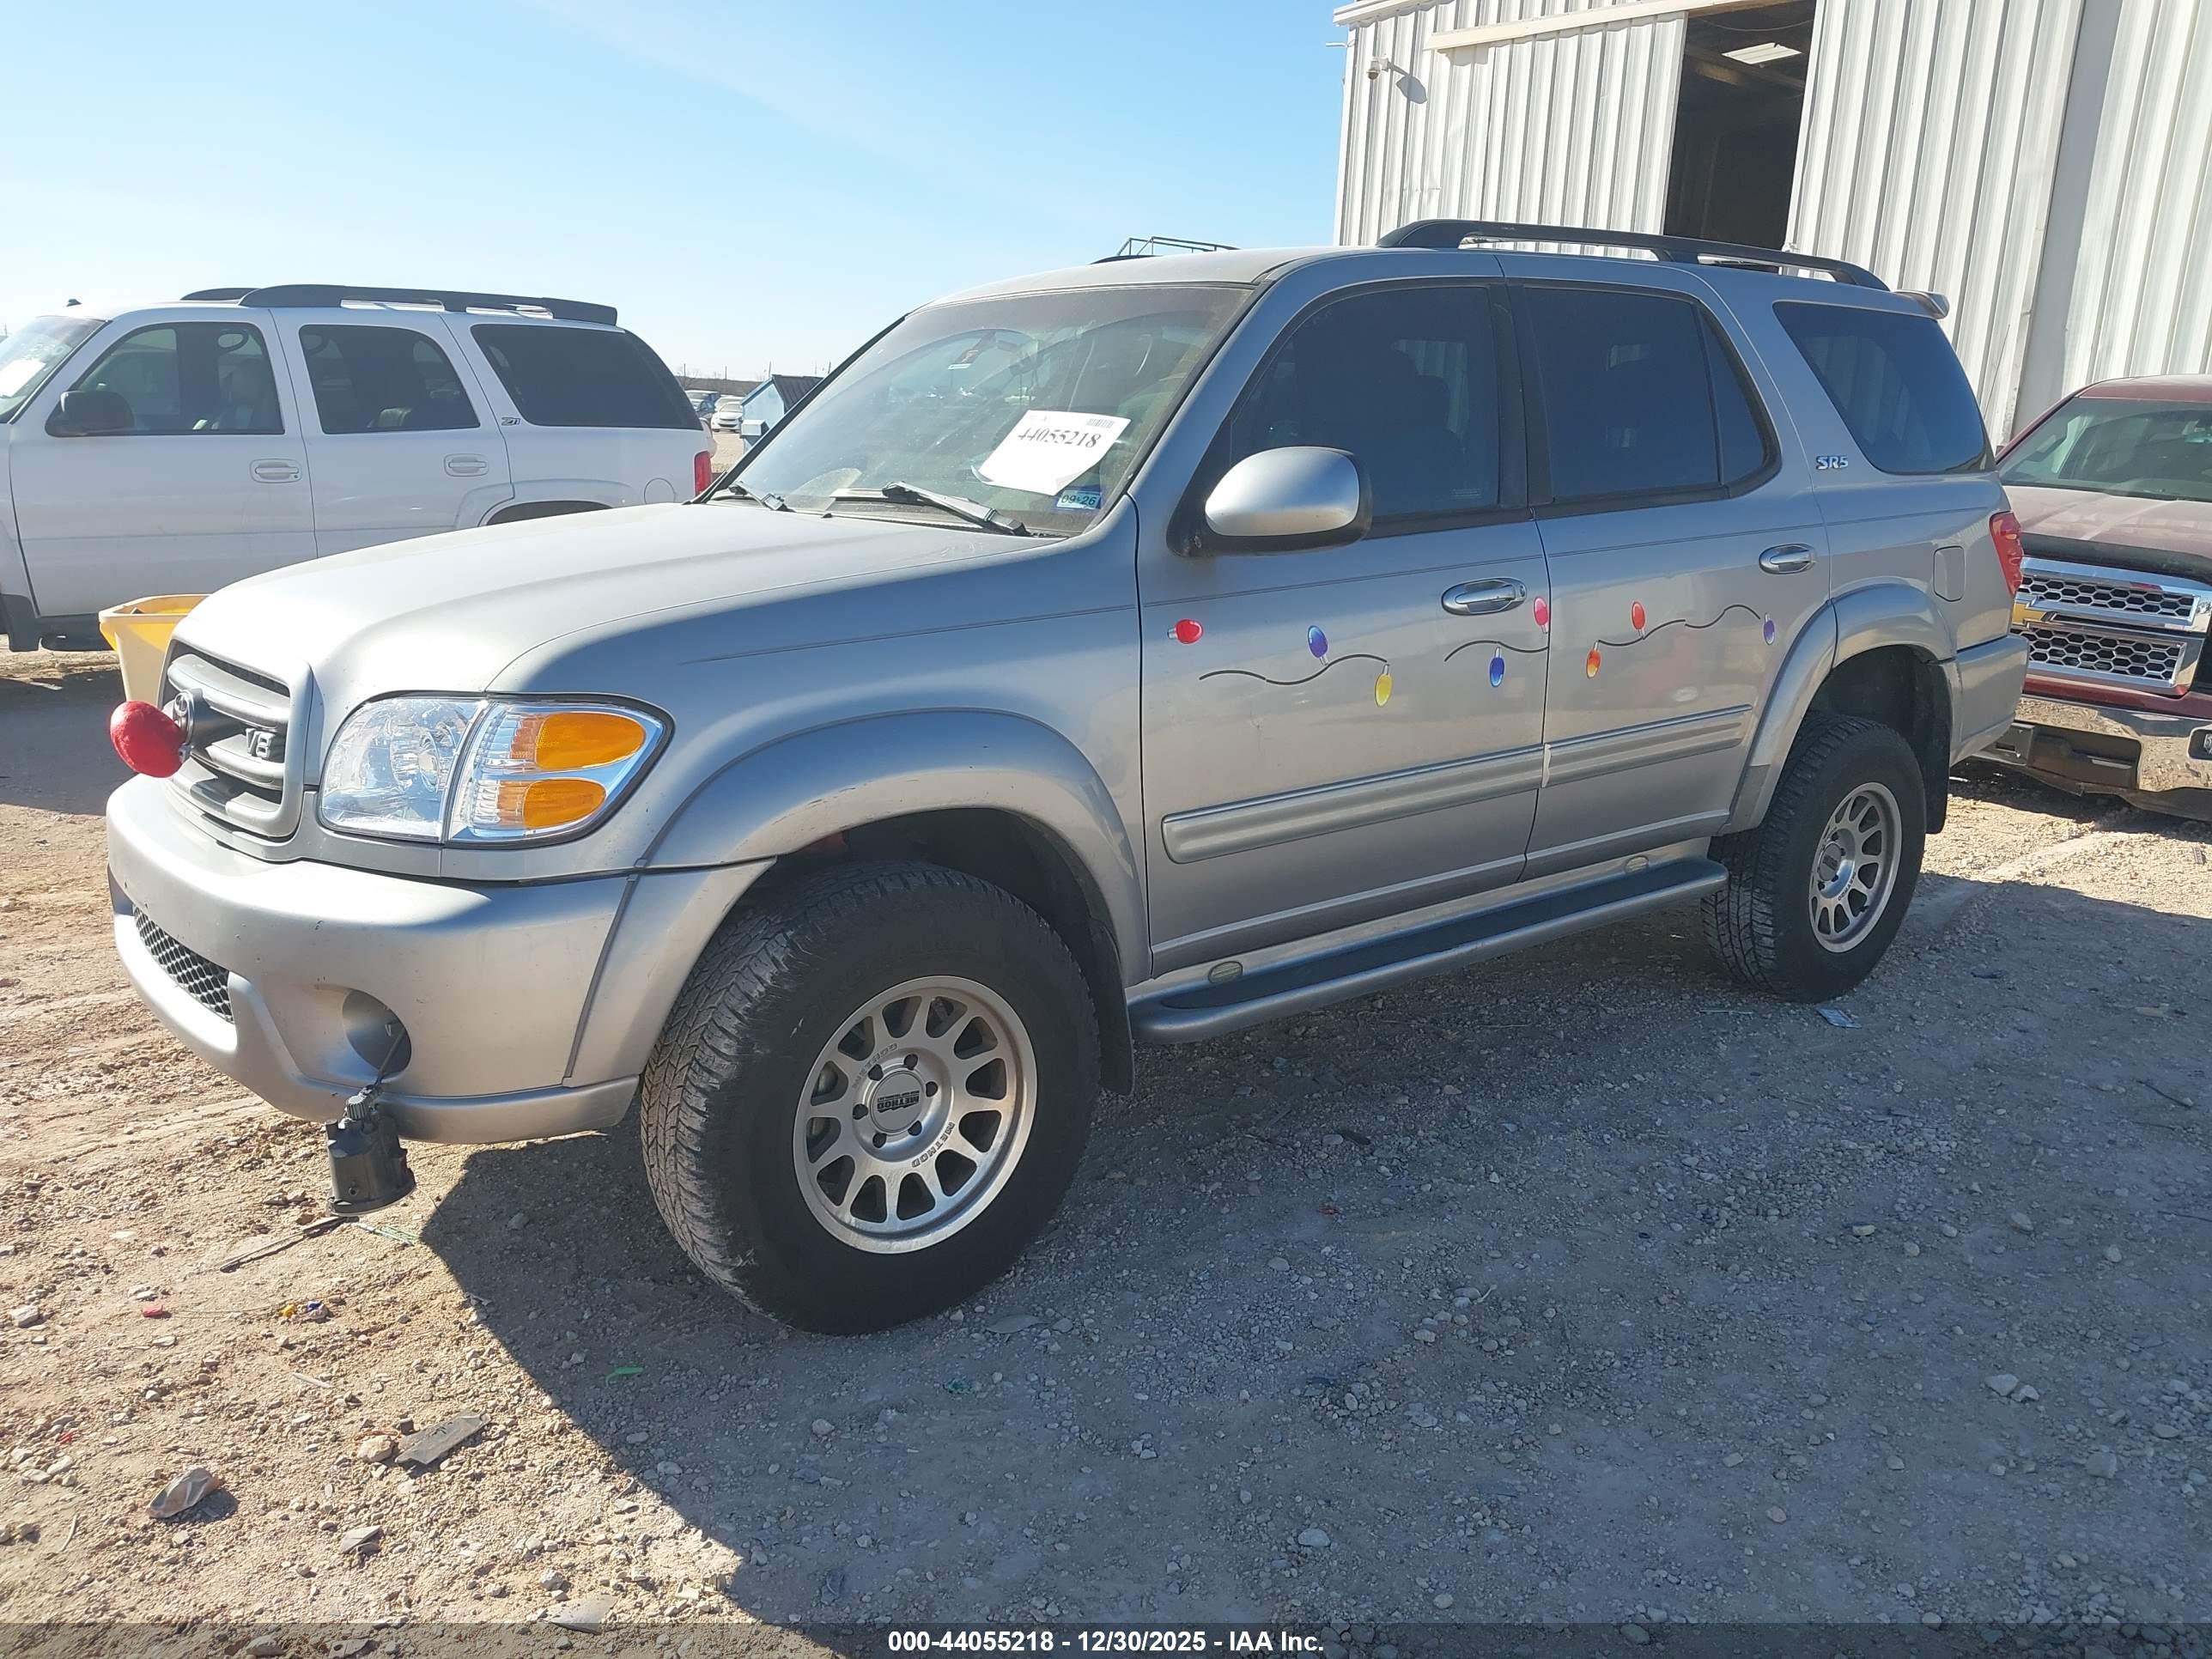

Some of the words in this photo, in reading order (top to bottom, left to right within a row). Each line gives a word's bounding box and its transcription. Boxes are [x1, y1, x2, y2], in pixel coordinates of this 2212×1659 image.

[1018, 427, 1103, 448] 44055218
[1816, 454, 1849, 470] SR5
[1080, 495, 1097, 506] 26
[246, 728, 276, 759] V8
[878, 1095, 920, 1111] METHOD
[911, 1121, 956, 1169] METHOD
